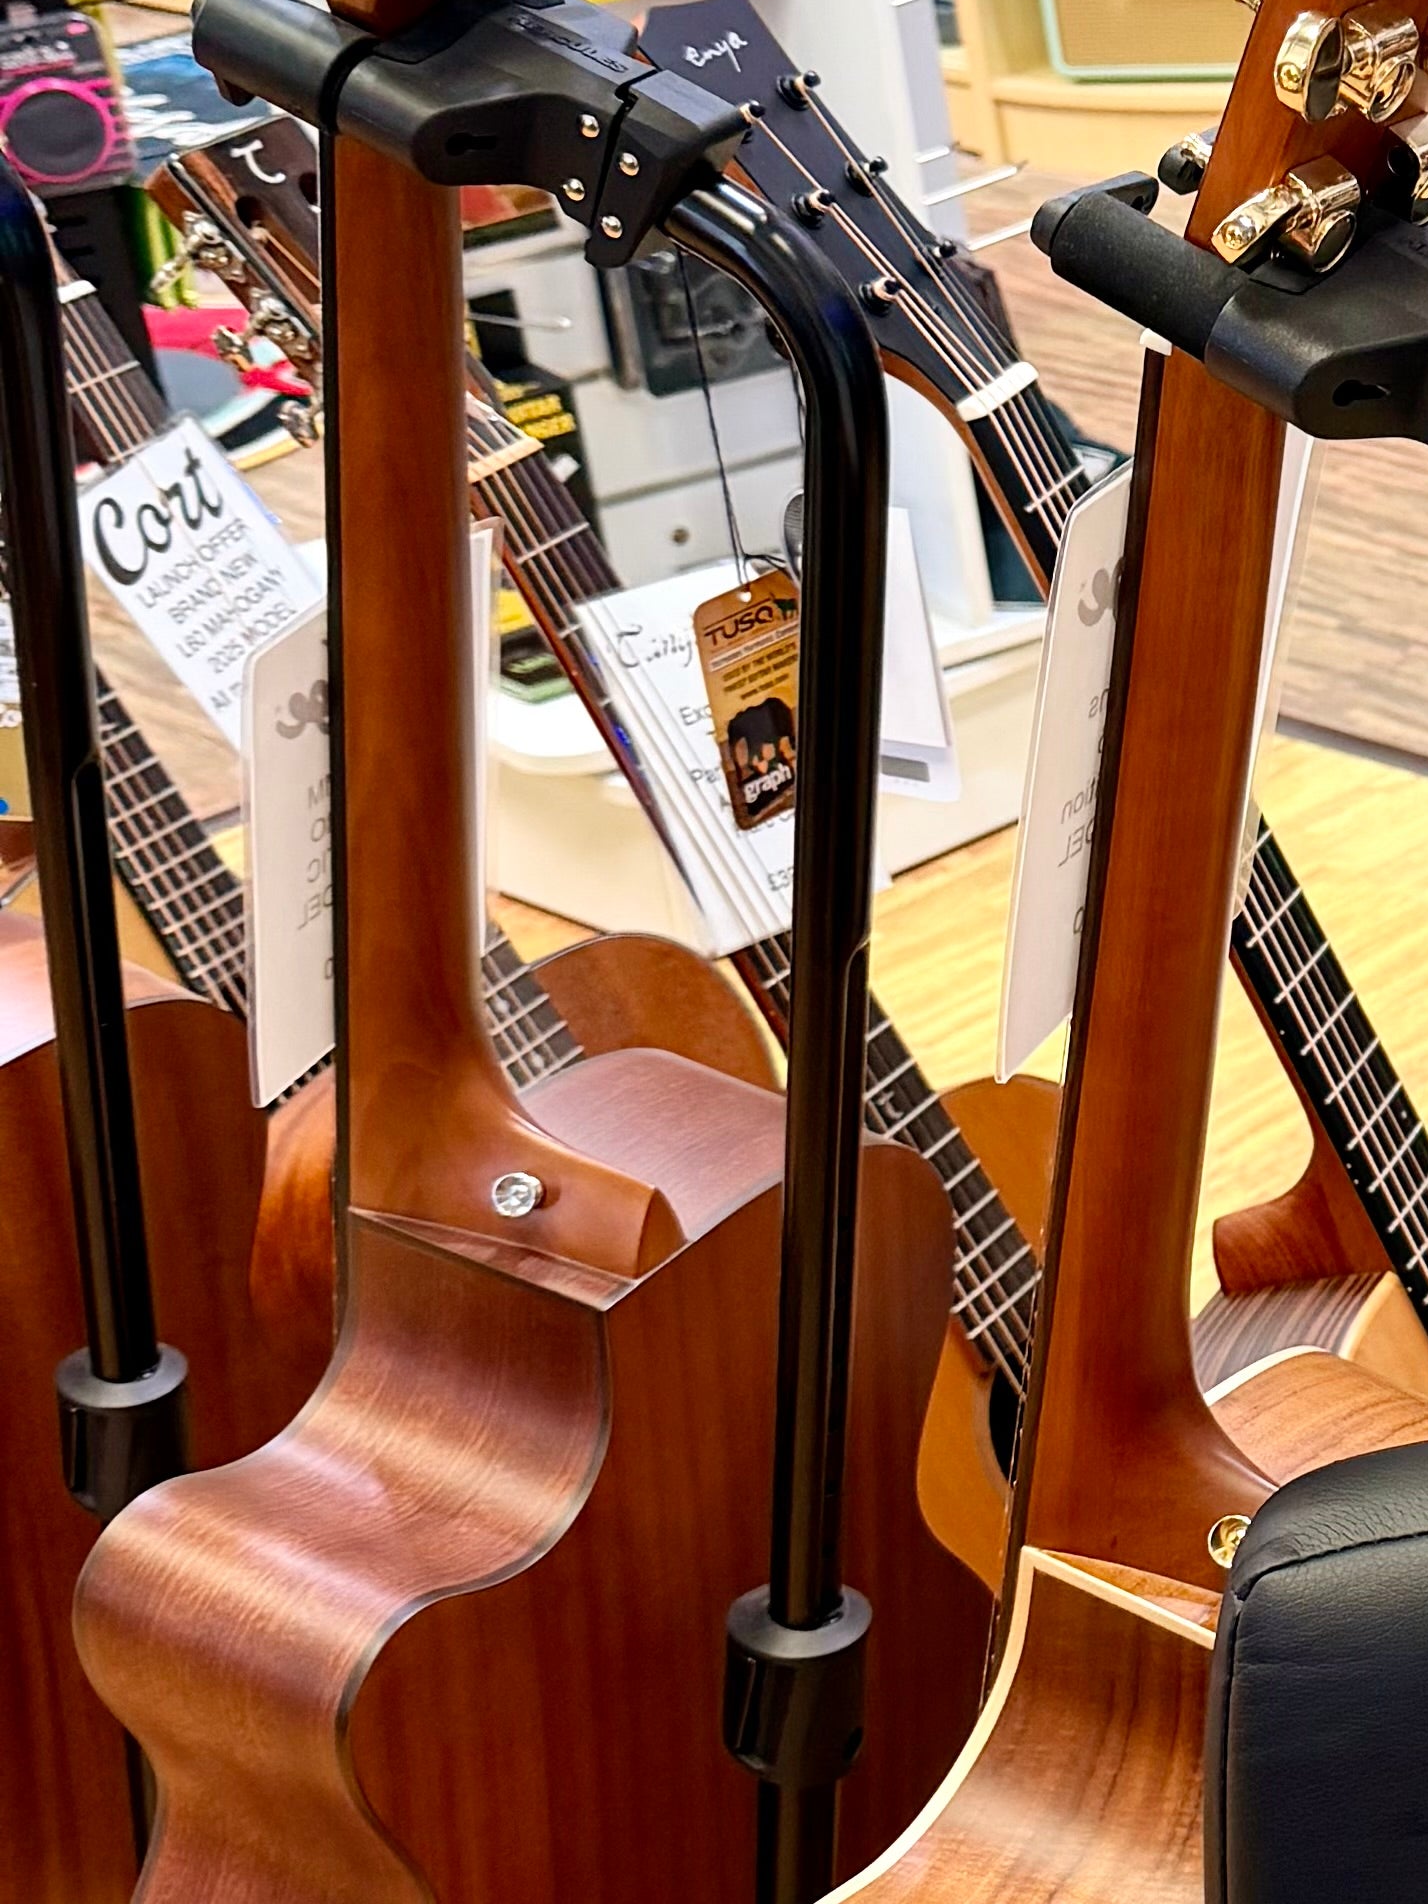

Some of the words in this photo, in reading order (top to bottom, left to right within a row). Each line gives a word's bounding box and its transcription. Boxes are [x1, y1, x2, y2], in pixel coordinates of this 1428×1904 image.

[92, 446, 224, 586] Cort
[137, 554, 199, 609] LAUNCH
[198, 516, 252, 564] OFFER
[167, 573, 226, 624] BRAND
[221, 549, 261, 587] NEW
[241, 606, 298, 649] MODEL
[703, 606, 765, 646] TUSQ
[739, 761, 788, 804] graph
